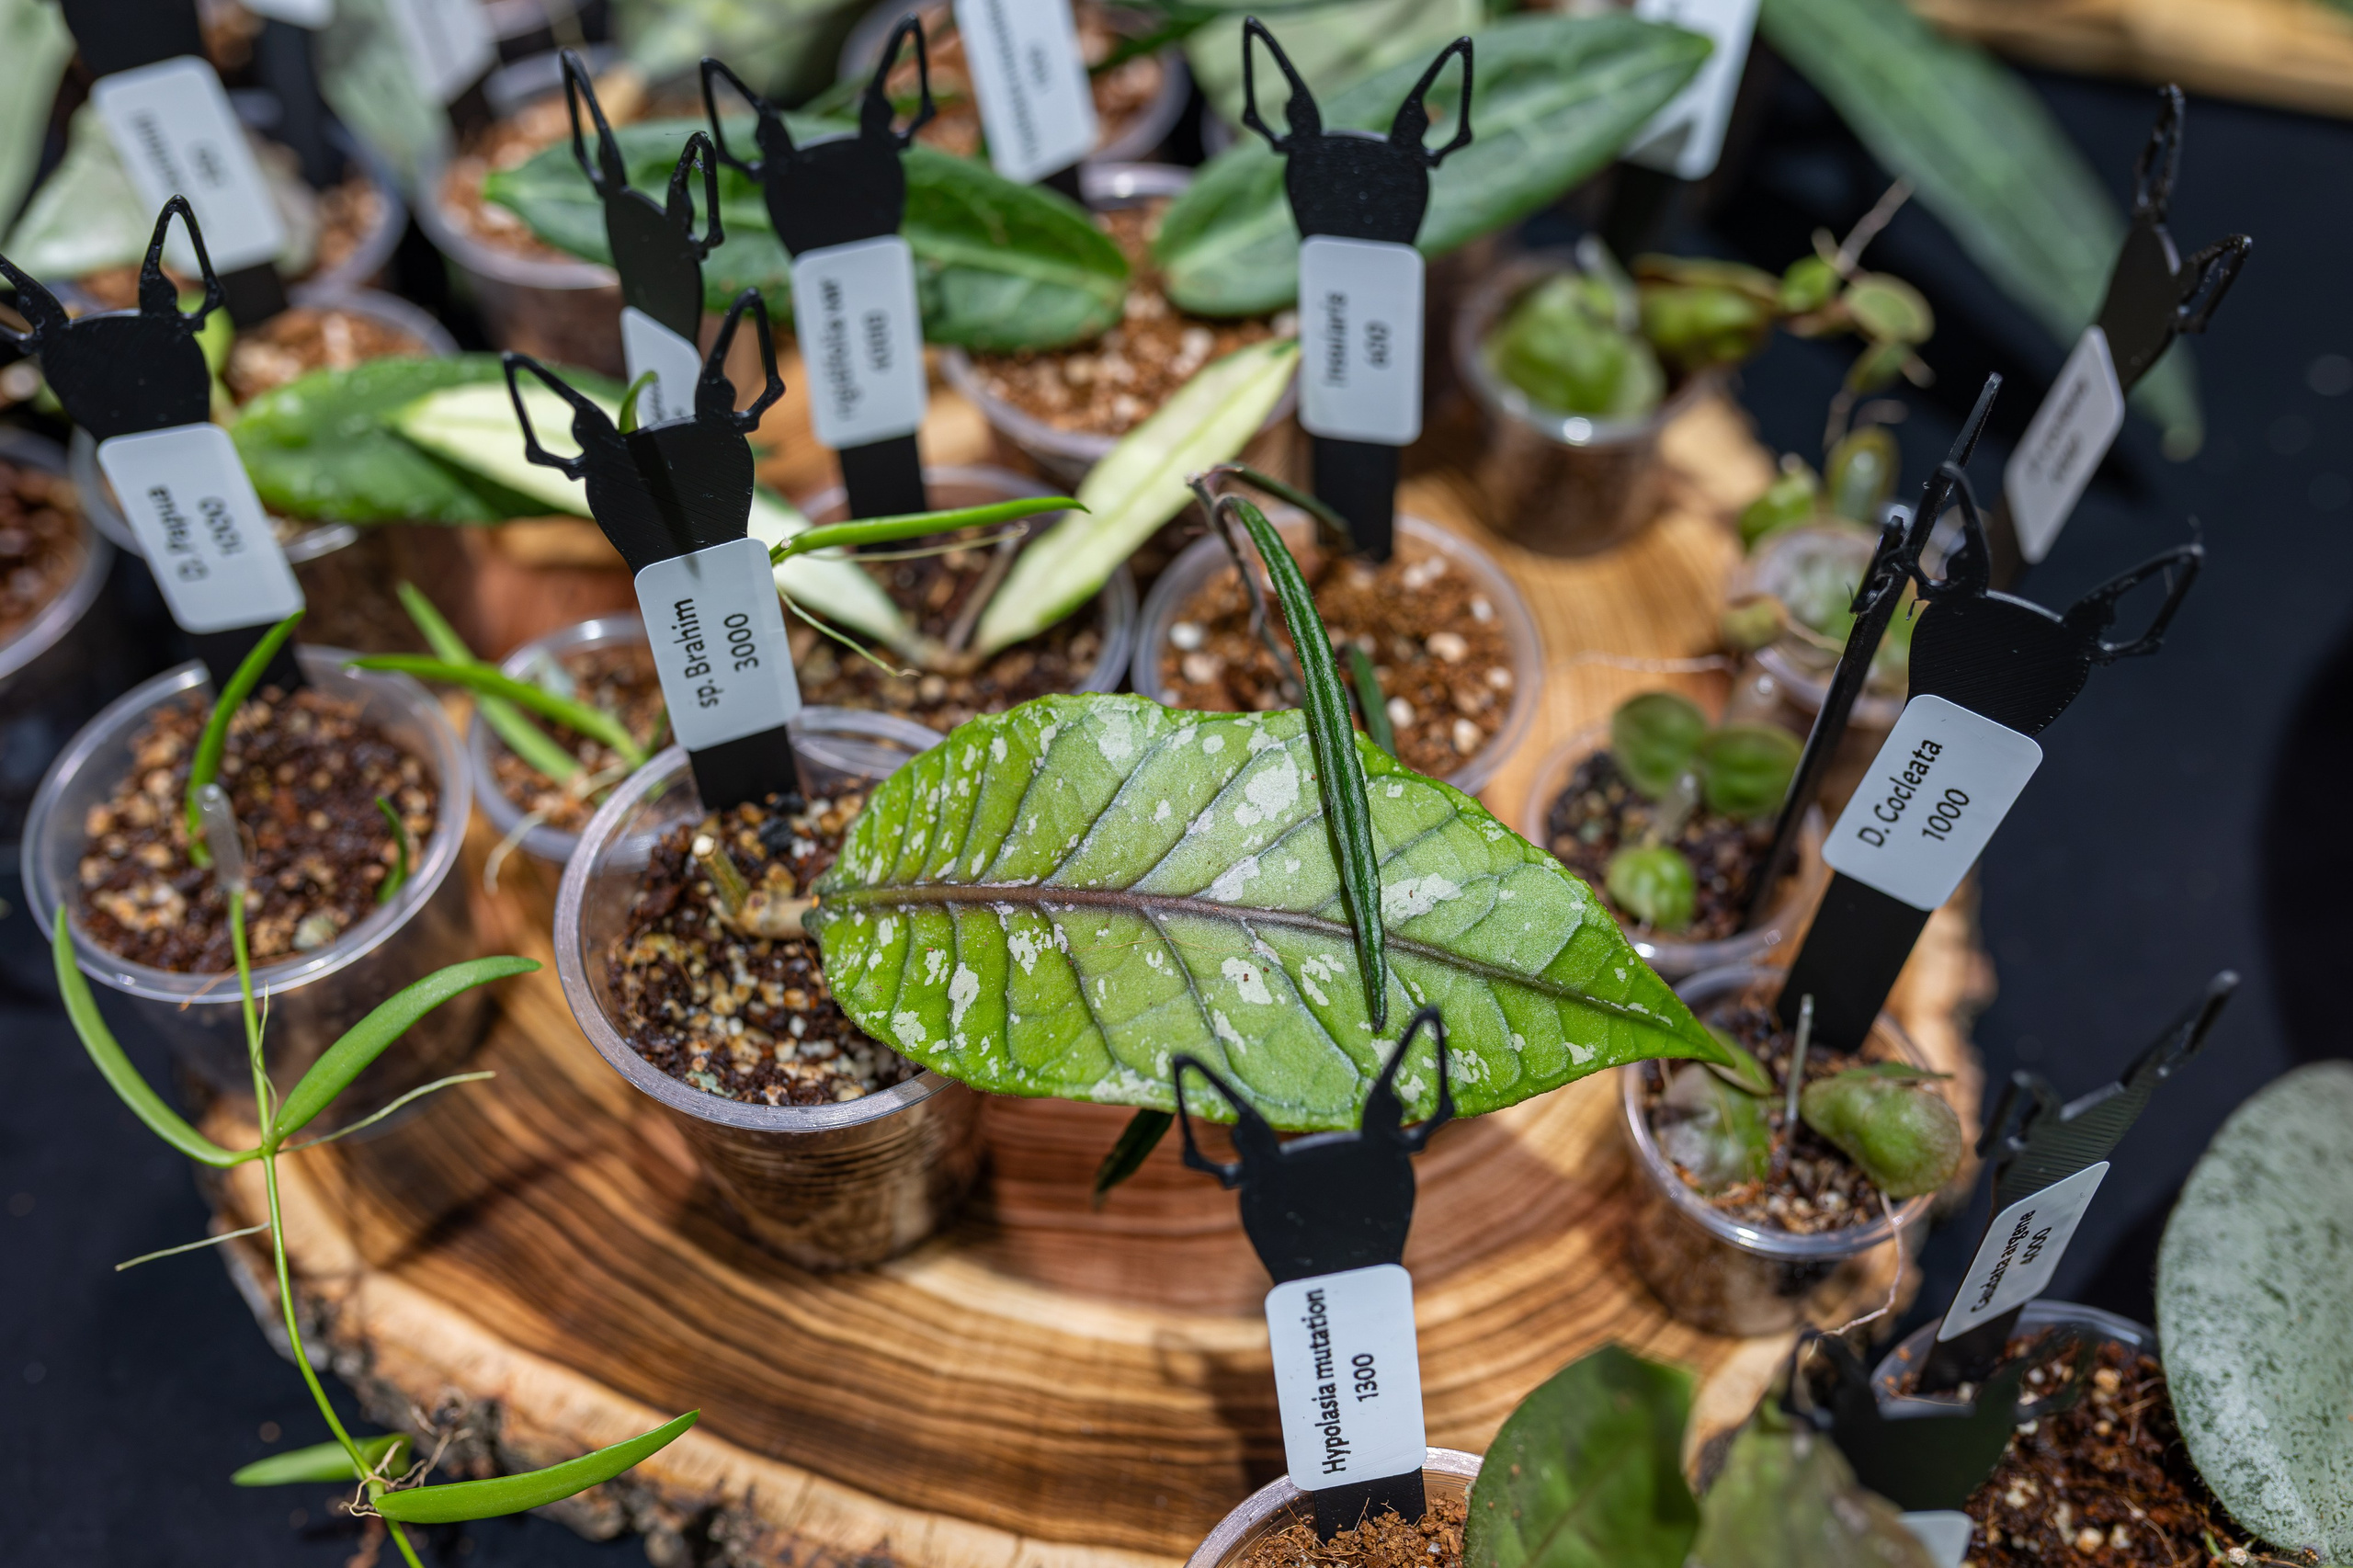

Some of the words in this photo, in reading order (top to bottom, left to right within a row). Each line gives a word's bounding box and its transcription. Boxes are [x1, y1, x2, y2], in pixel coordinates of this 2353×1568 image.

[671, 598, 712, 678] Brahim
[723, 613, 760, 673] 3000
[696, 678, 723, 709] sp.
[1873, 739, 1943, 824] Cocleata
[1857, 825, 1892, 848] D.
[1921, 788, 1970, 841] 1000
[2020, 1226, 2052, 1266] 4000
[1970, 1256, 2014, 1312] Caudata
[1301, 1288, 1335, 1380] mutation
[1350, 1352, 1379, 1403] 1300
[1311, 1383, 1352, 1475] Hypolasia
